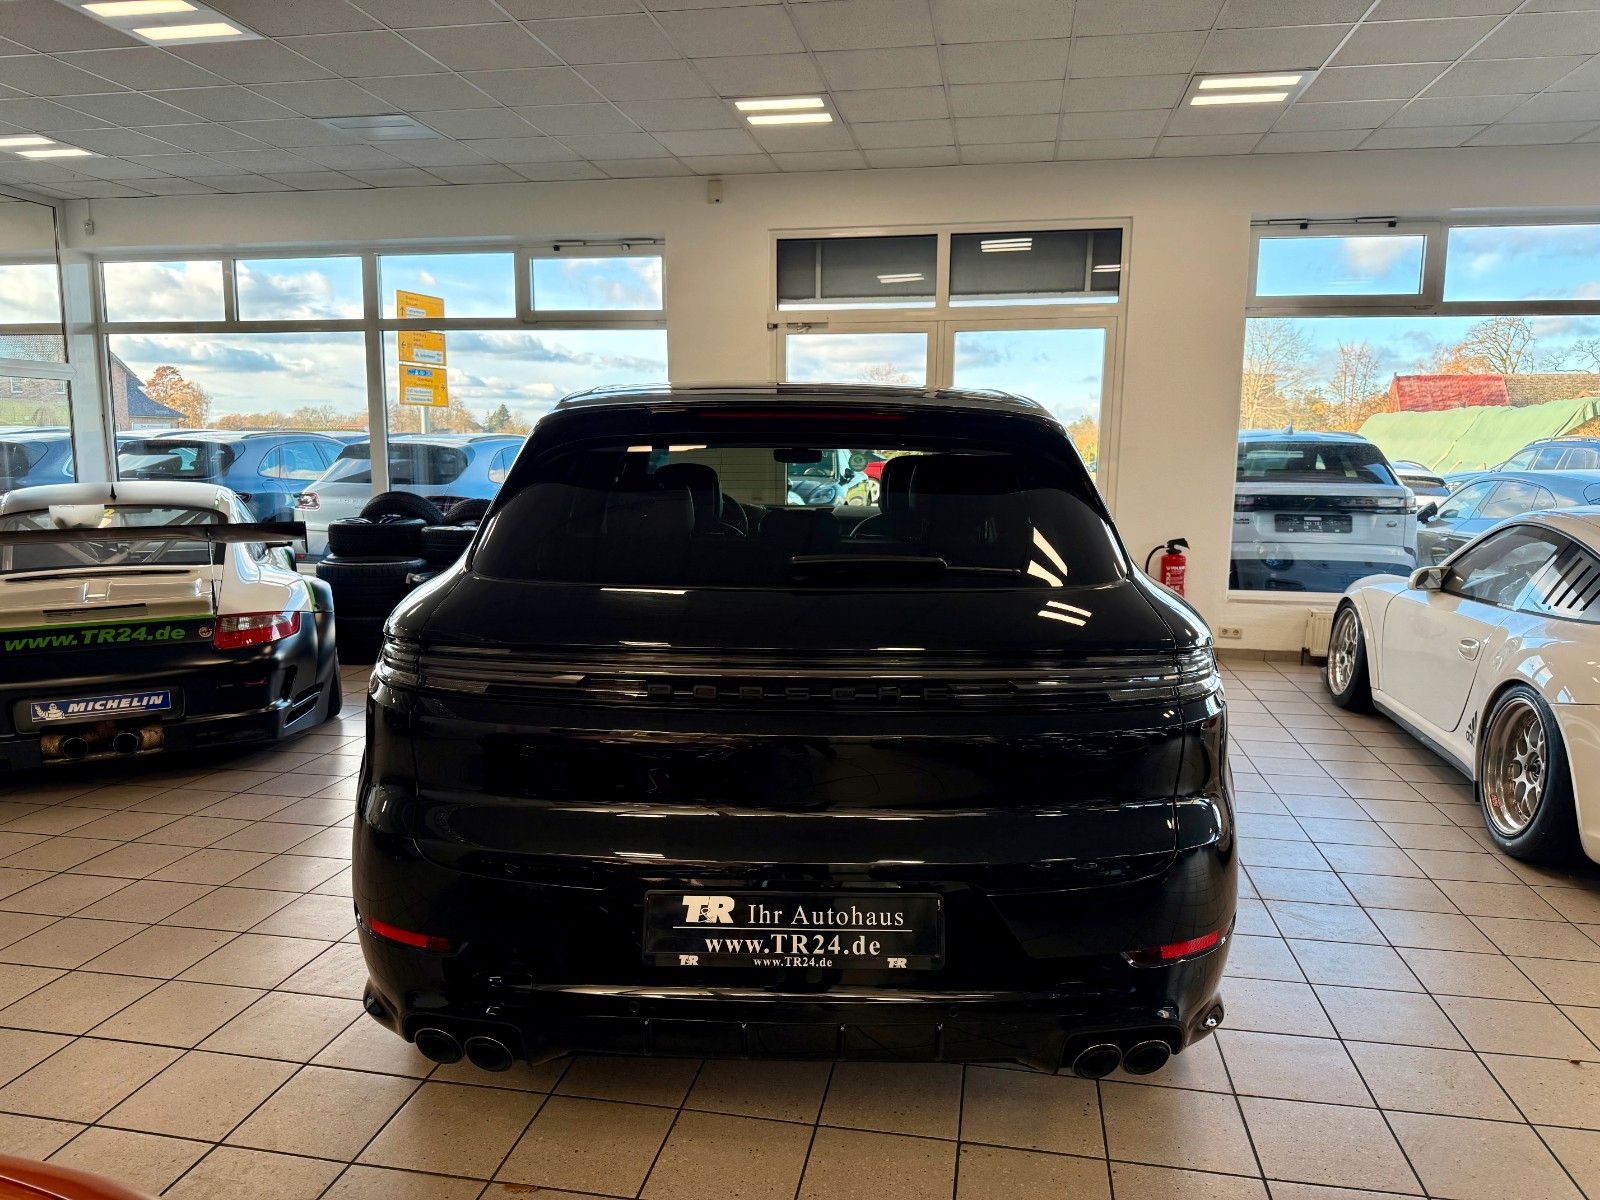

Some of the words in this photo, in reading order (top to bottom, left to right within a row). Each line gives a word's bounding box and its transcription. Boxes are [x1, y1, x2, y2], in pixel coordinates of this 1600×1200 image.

[4, 626, 186, 652] www.TR24.de
[67, 694, 164, 714] MICHELIN
[747, 903, 783, 925] Ihr
[790, 904, 905, 926] Autohaus
[704, 933, 882, 956] www.TR24.de
[752, 956, 834, 968] www.TR24.de
